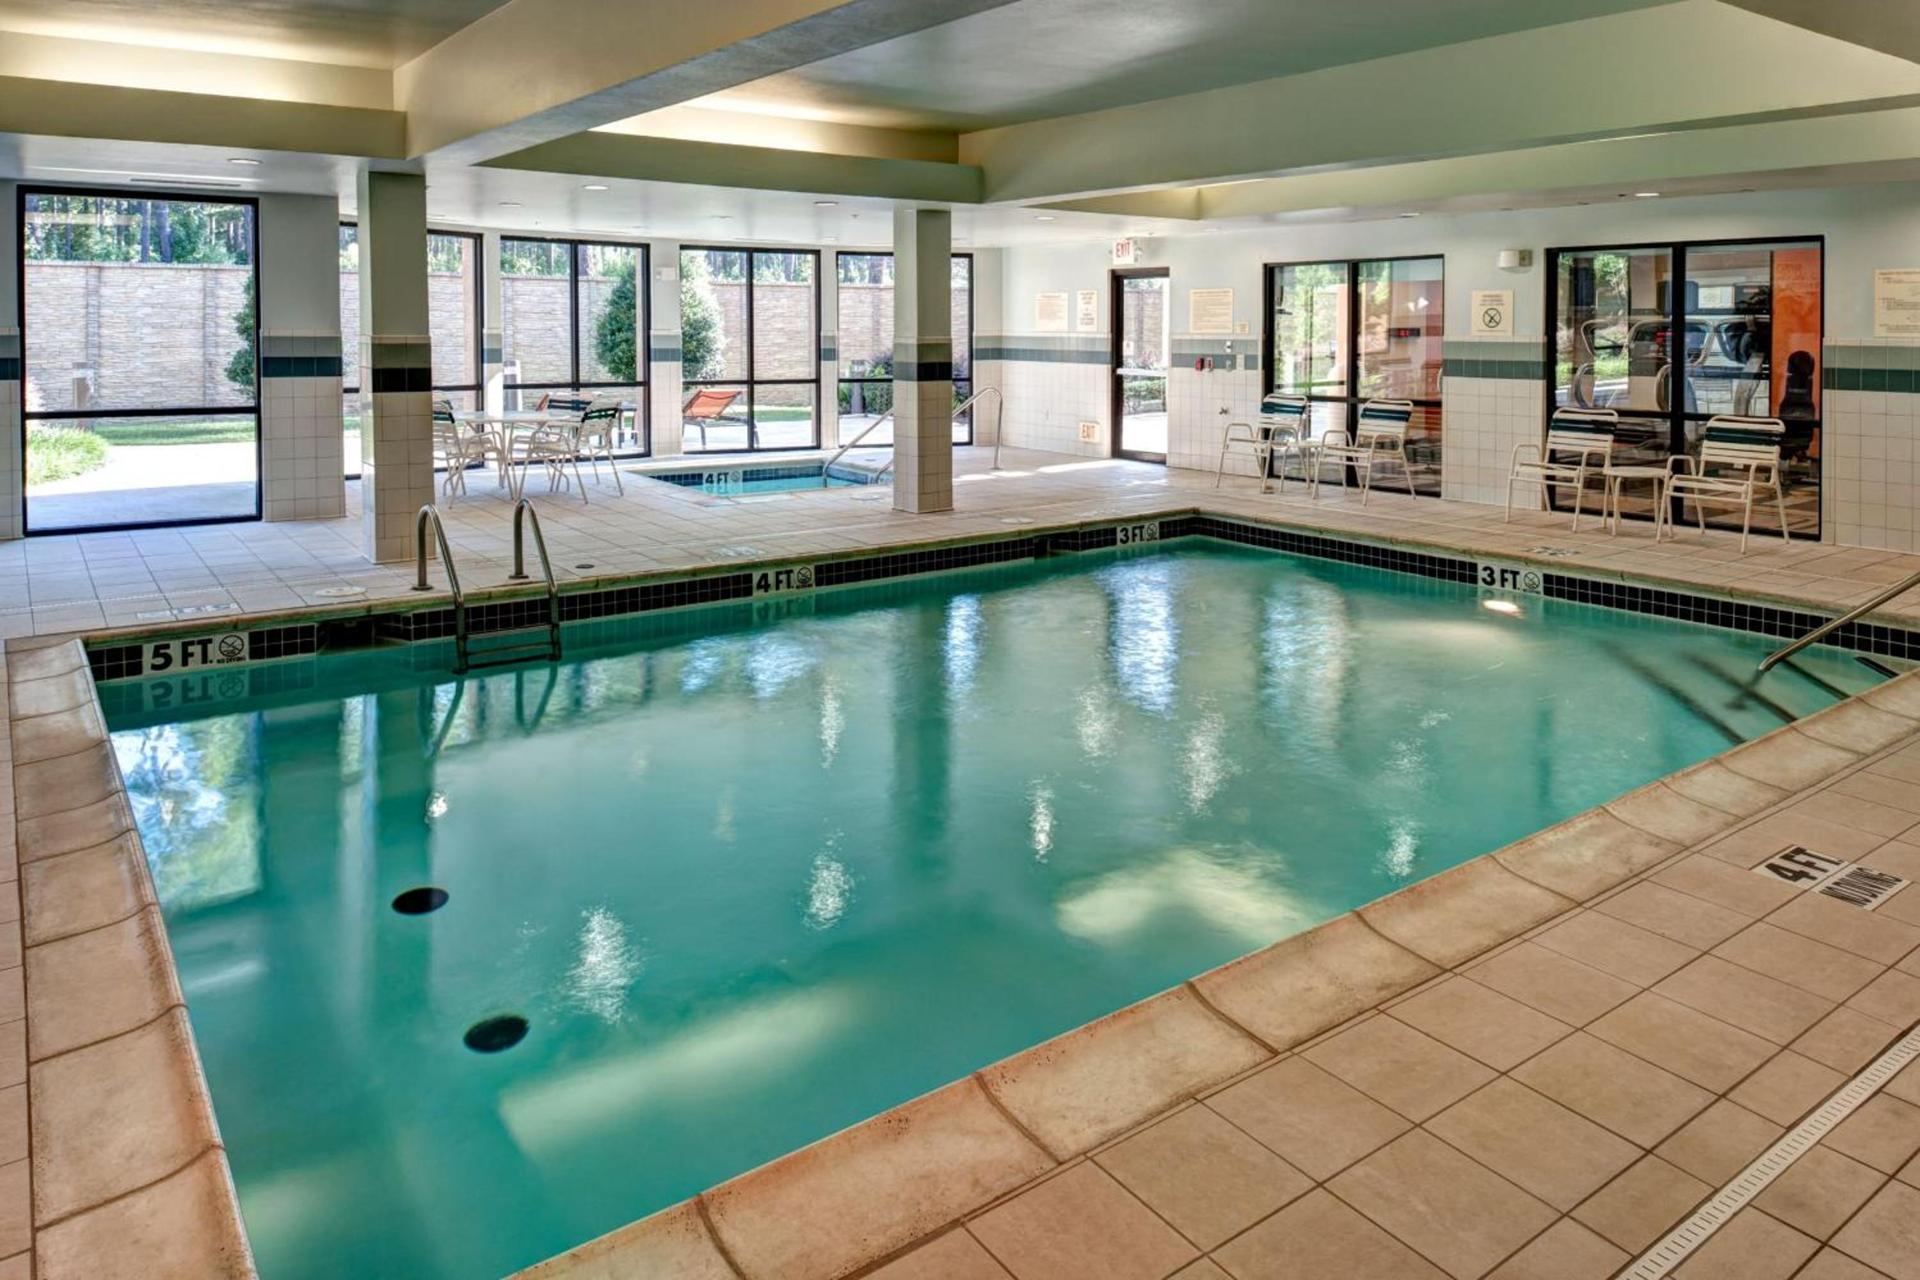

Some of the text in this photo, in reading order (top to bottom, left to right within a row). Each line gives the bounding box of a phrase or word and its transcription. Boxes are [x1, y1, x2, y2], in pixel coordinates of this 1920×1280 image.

[1115, 242, 1131, 257] EXIT
[1082, 423, 1096, 439] EXIT
[705, 473, 715, 484] 4
[1120, 527, 1130, 545] 3
[756, 573, 771, 593] 4
[1481, 566, 1496, 587] 3
[151, 643, 173, 671] 5
[1764, 862, 1818, 883] 4
